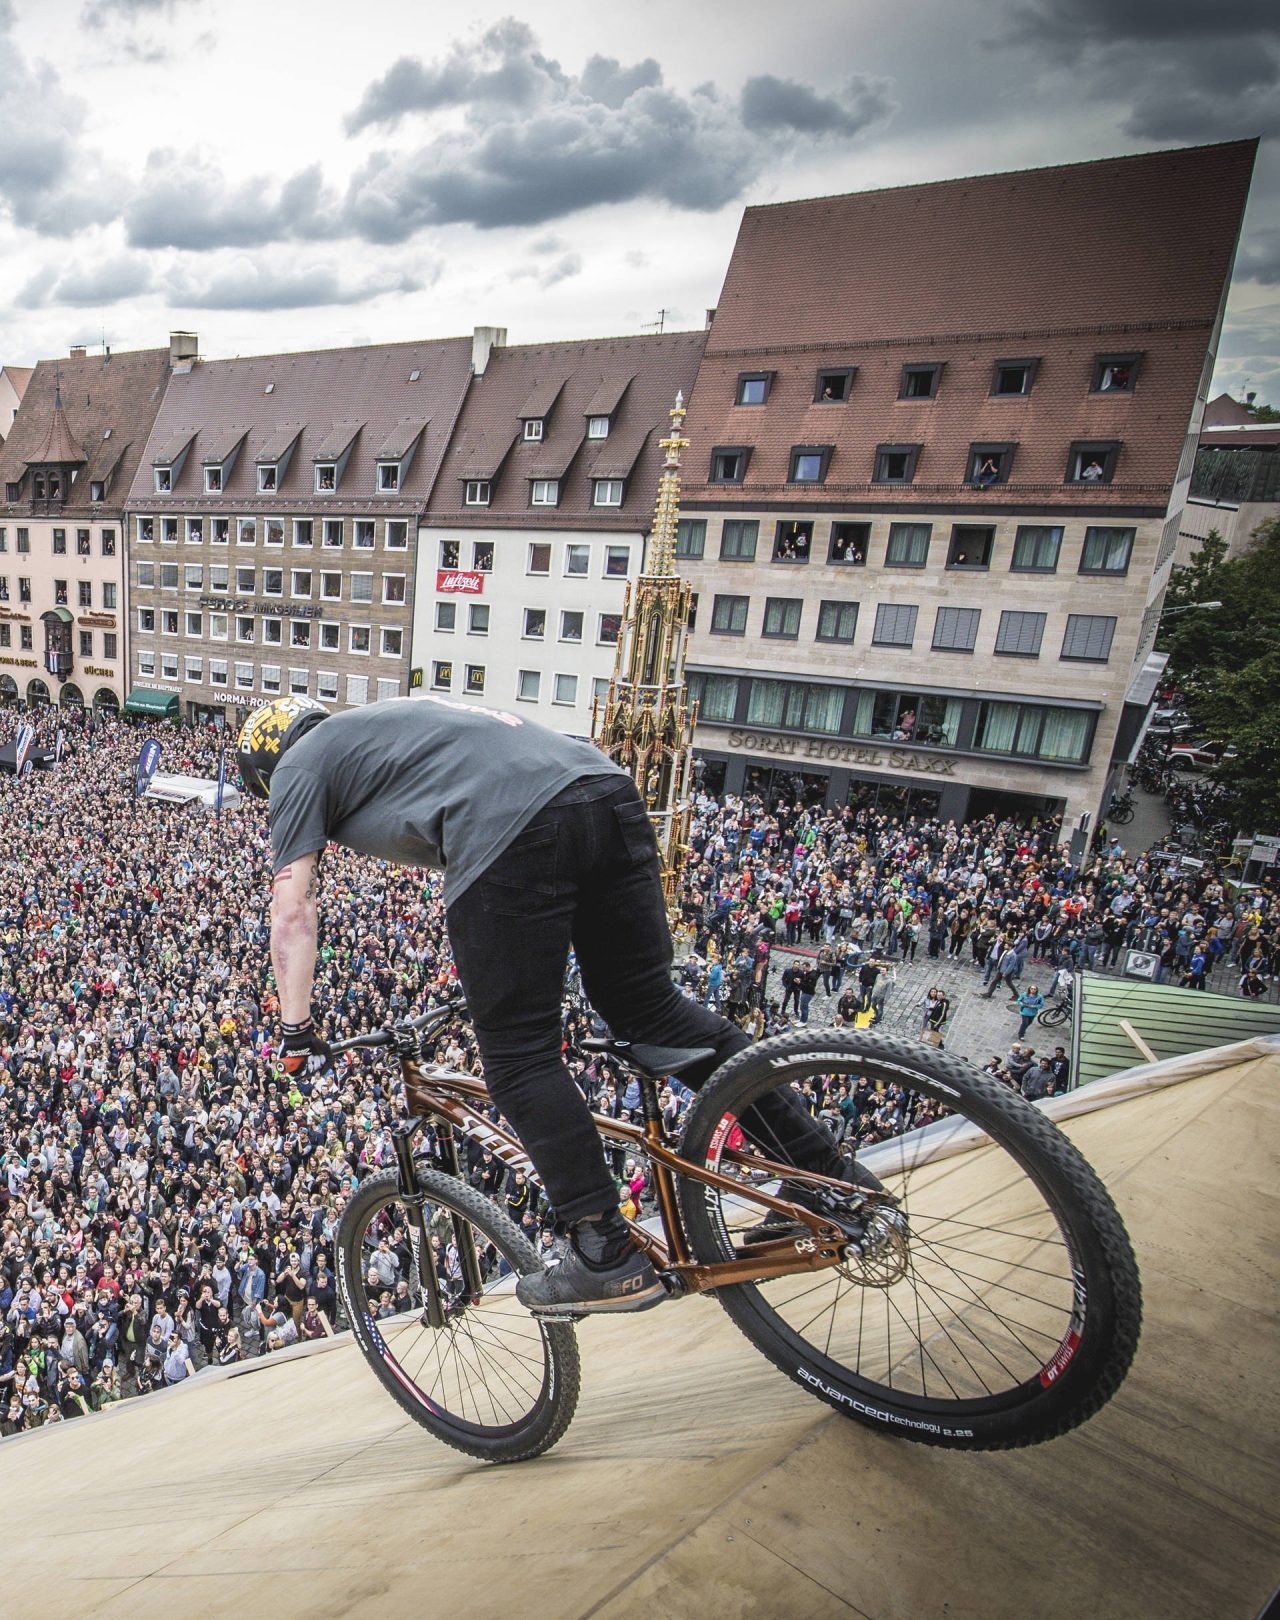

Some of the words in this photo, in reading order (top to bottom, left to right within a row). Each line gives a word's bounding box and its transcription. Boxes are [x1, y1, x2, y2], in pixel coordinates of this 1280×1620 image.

[728, 730, 800, 754] SORAT
[804, 740, 882, 766] HOTEL
[888, 750, 958, 775] SAXX
[788, 1052, 863, 1063] MICHELIN
[797, 1367, 889, 1422] advanced
[889, 1414, 940, 1434] technology
[943, 1429, 973, 1437] 2.25
